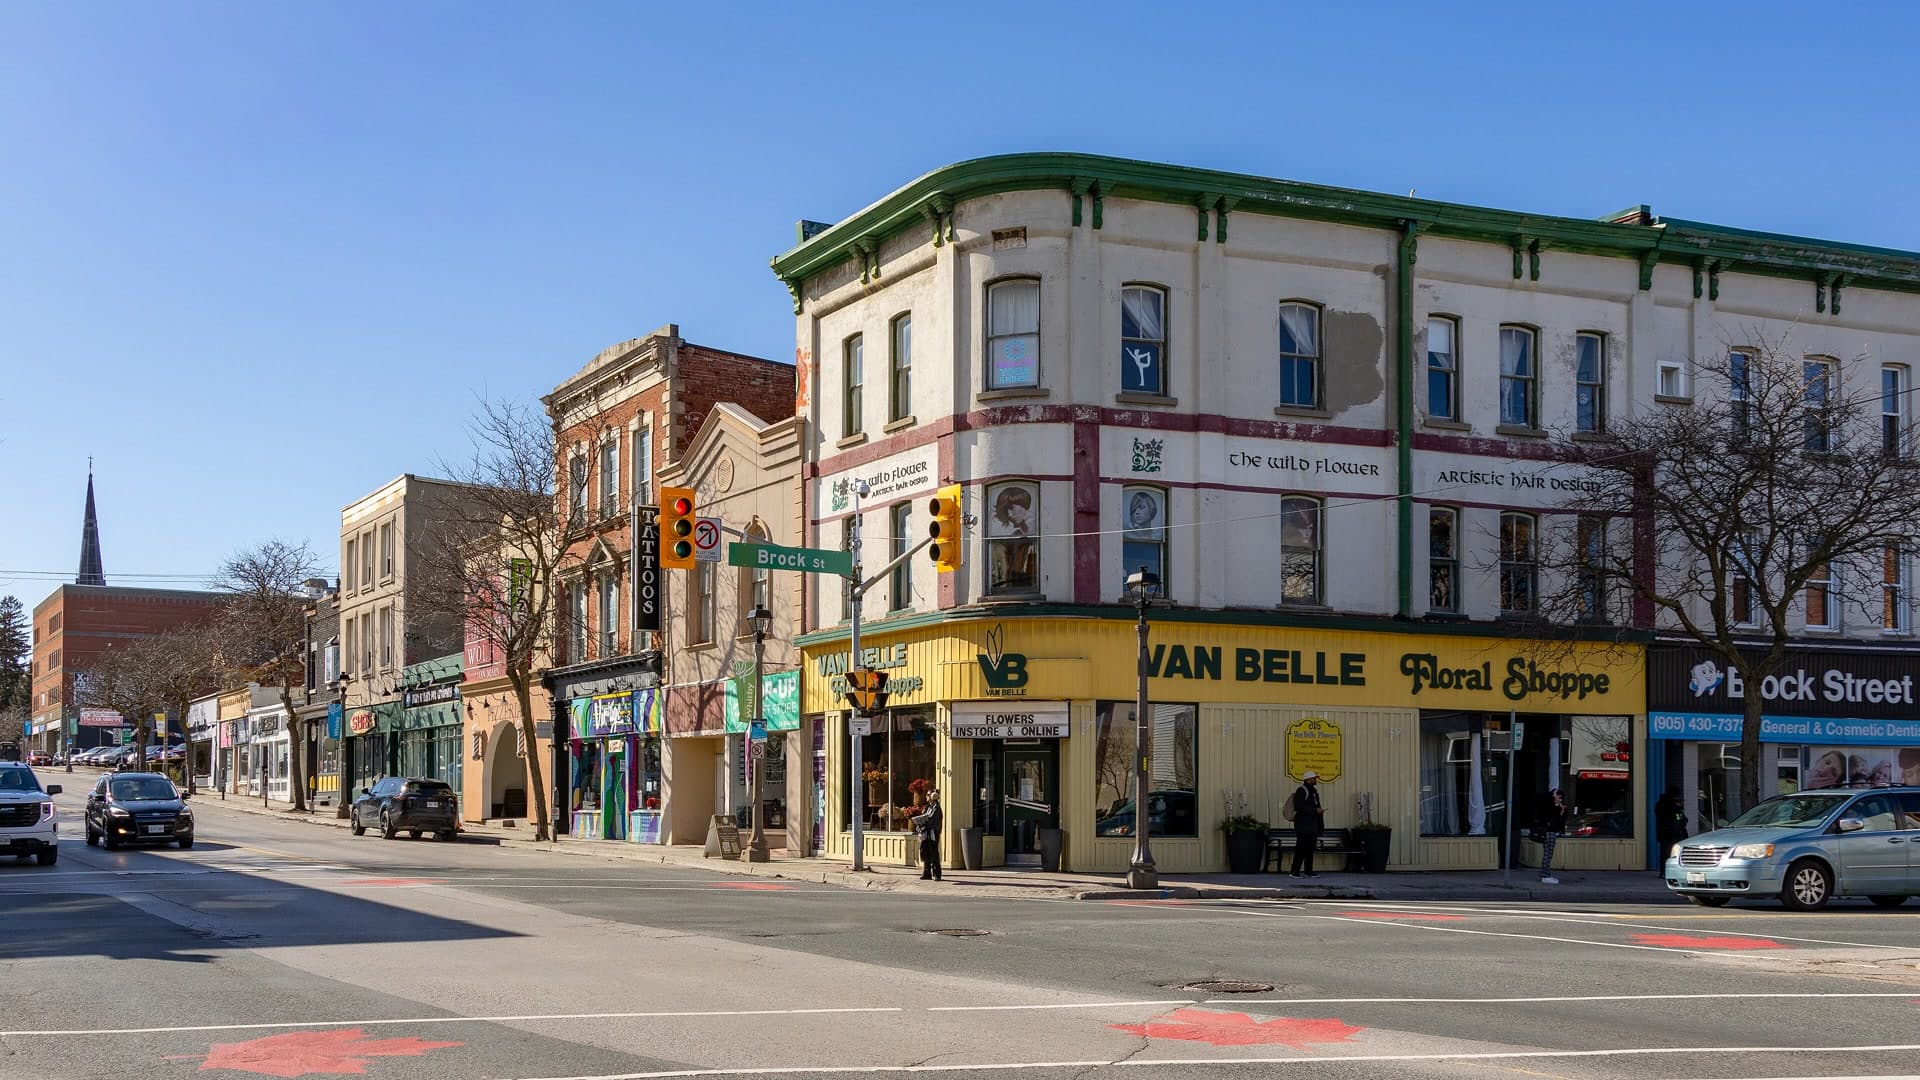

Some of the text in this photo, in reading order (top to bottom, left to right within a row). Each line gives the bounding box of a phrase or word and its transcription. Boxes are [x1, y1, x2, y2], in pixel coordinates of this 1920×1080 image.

[642, 510, 655, 615] TATTOOS
[758, 549, 825, 569] Brock St
[817, 651, 849, 677] VAN
[1146, 643, 1366, 687] VAN BELLE
[1400, 653, 1610, 701] Floral Shoppe
[1727, 665, 1913, 704] Bock Street
[985, 687, 1027, 696] VAN BELLE
[956, 725, 1059, 738] INSTORE & ONLINE
[985, 714, 1034, 725] FLOWERS
[1654, 715, 1685, 733] (905)
[1761, 719, 1810, 735] General
[1813, 721, 1823, 735] &
[1826, 722, 1885, 737] Cosmetic
